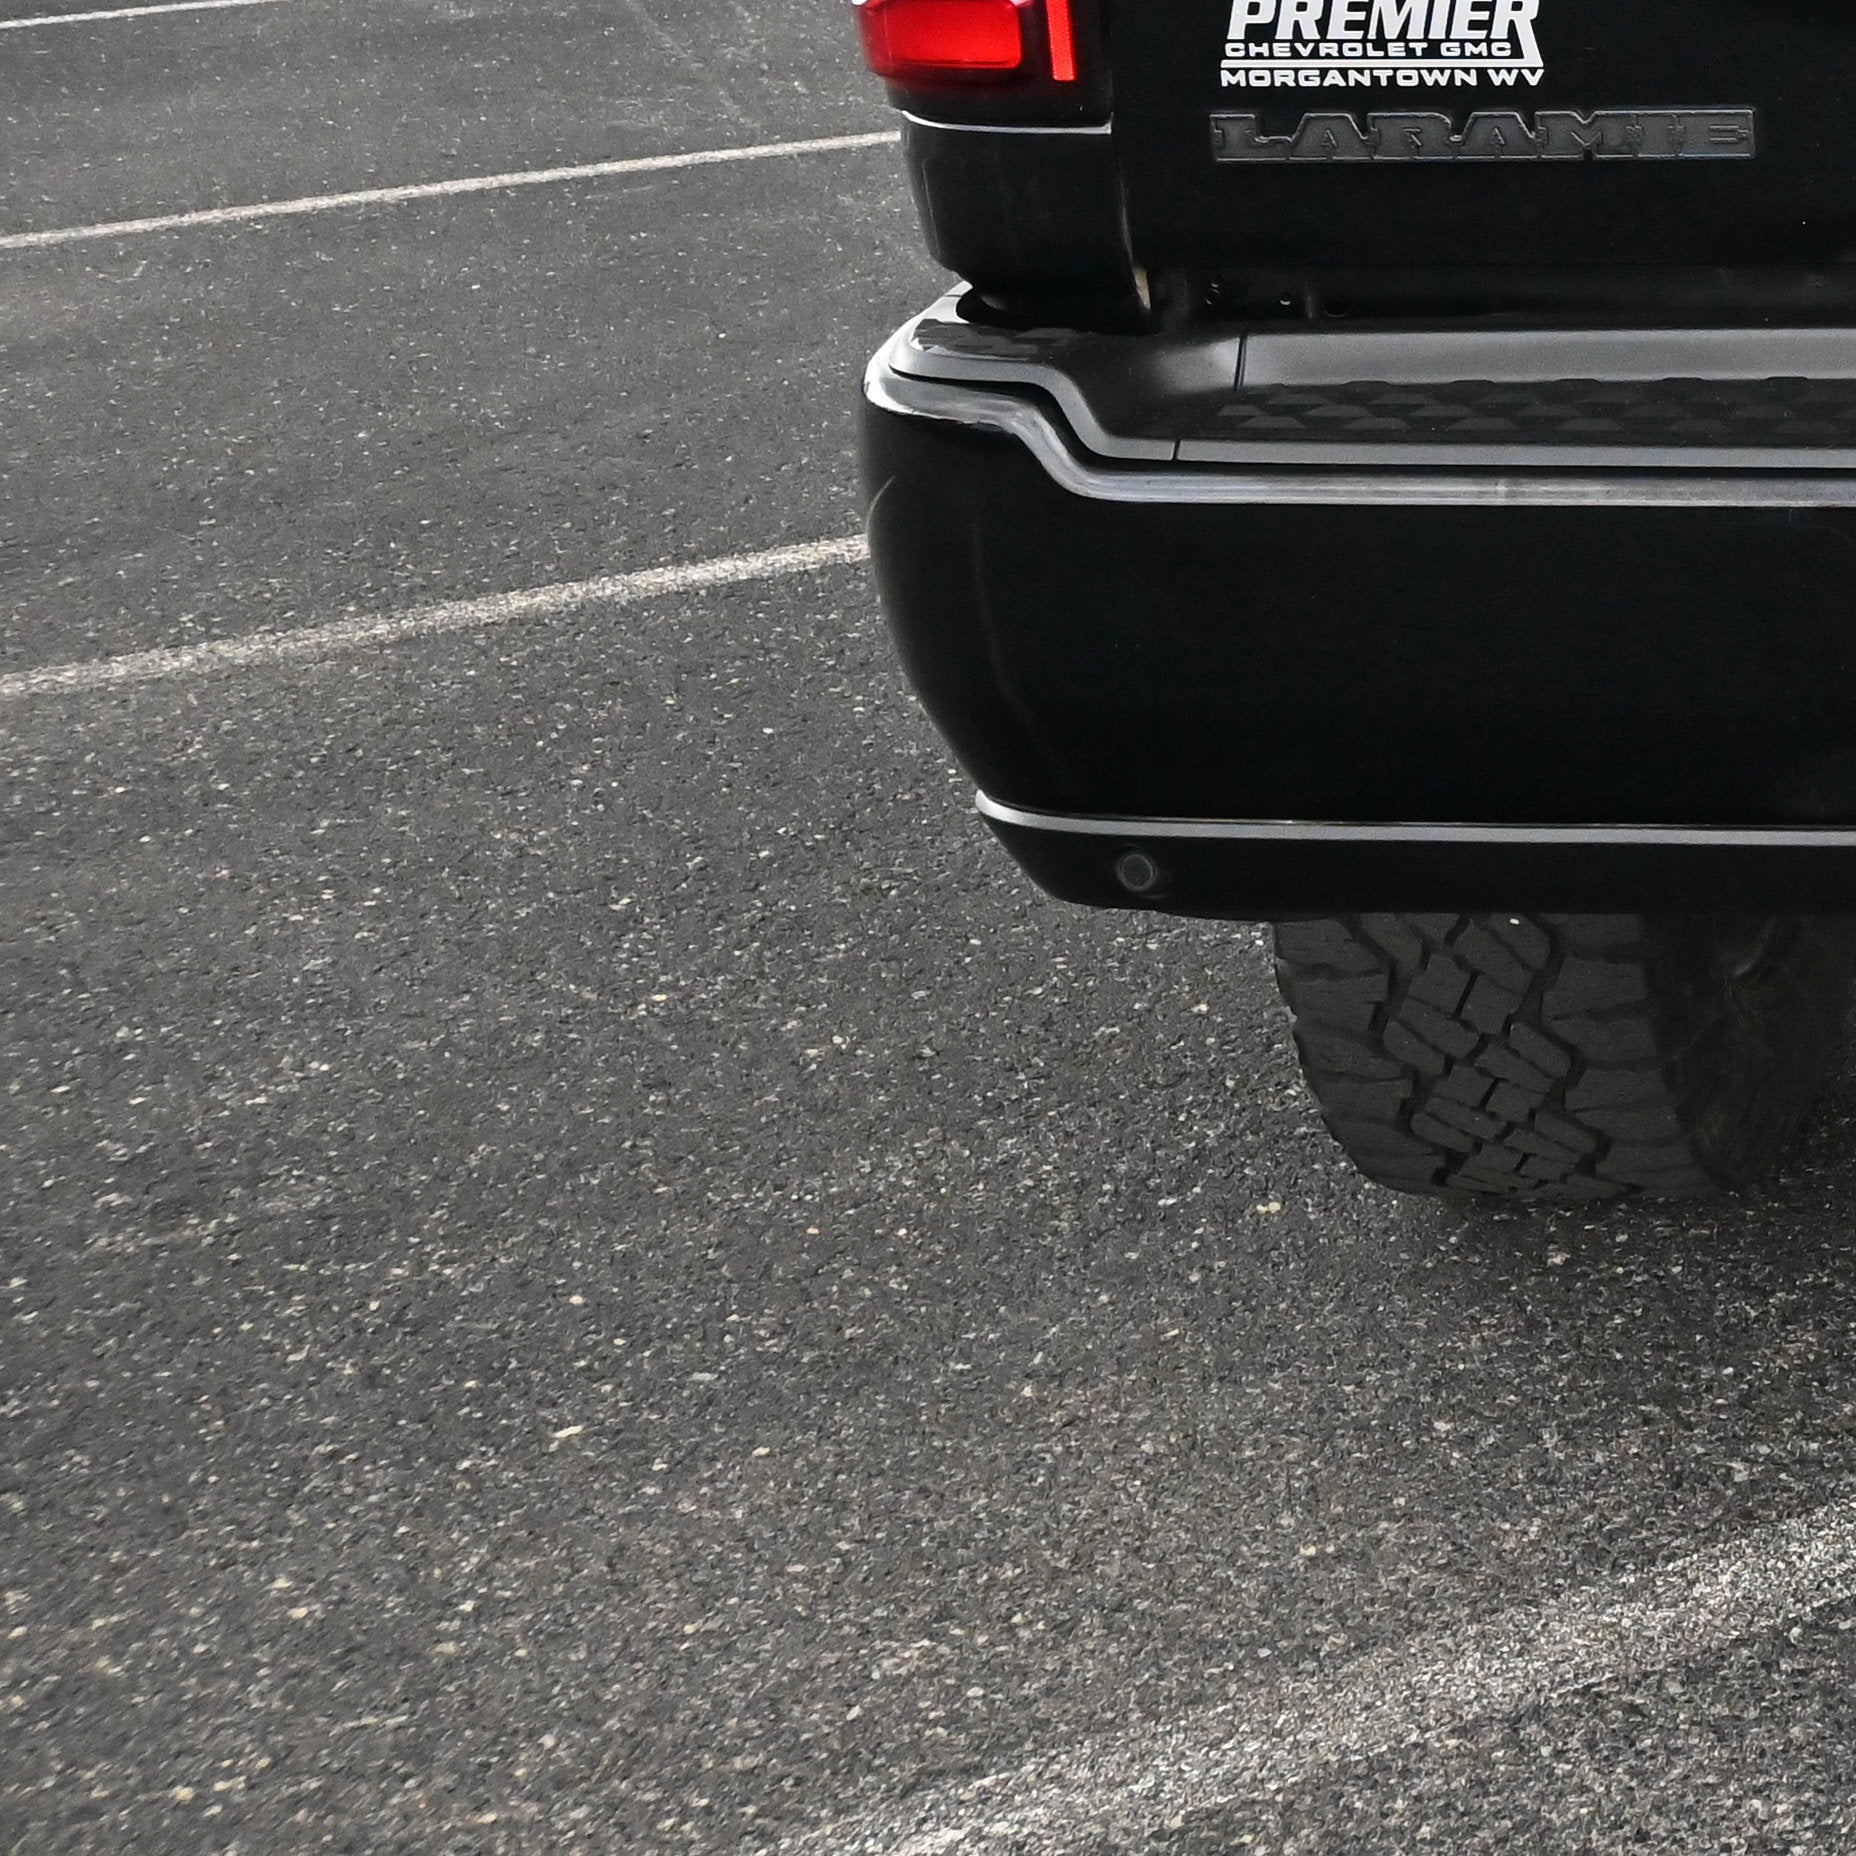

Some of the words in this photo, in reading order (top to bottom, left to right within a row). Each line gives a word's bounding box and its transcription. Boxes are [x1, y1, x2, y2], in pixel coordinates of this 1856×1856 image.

[1224, 42, 1429, 57] CHEVROLET
[1440, 42, 1512, 57] GMC
[1220, 69, 1478, 87] MORGANTOWN
[1487, 68, 1545, 86] WV
[1209, 107, 1756, 162] LARAMIE
